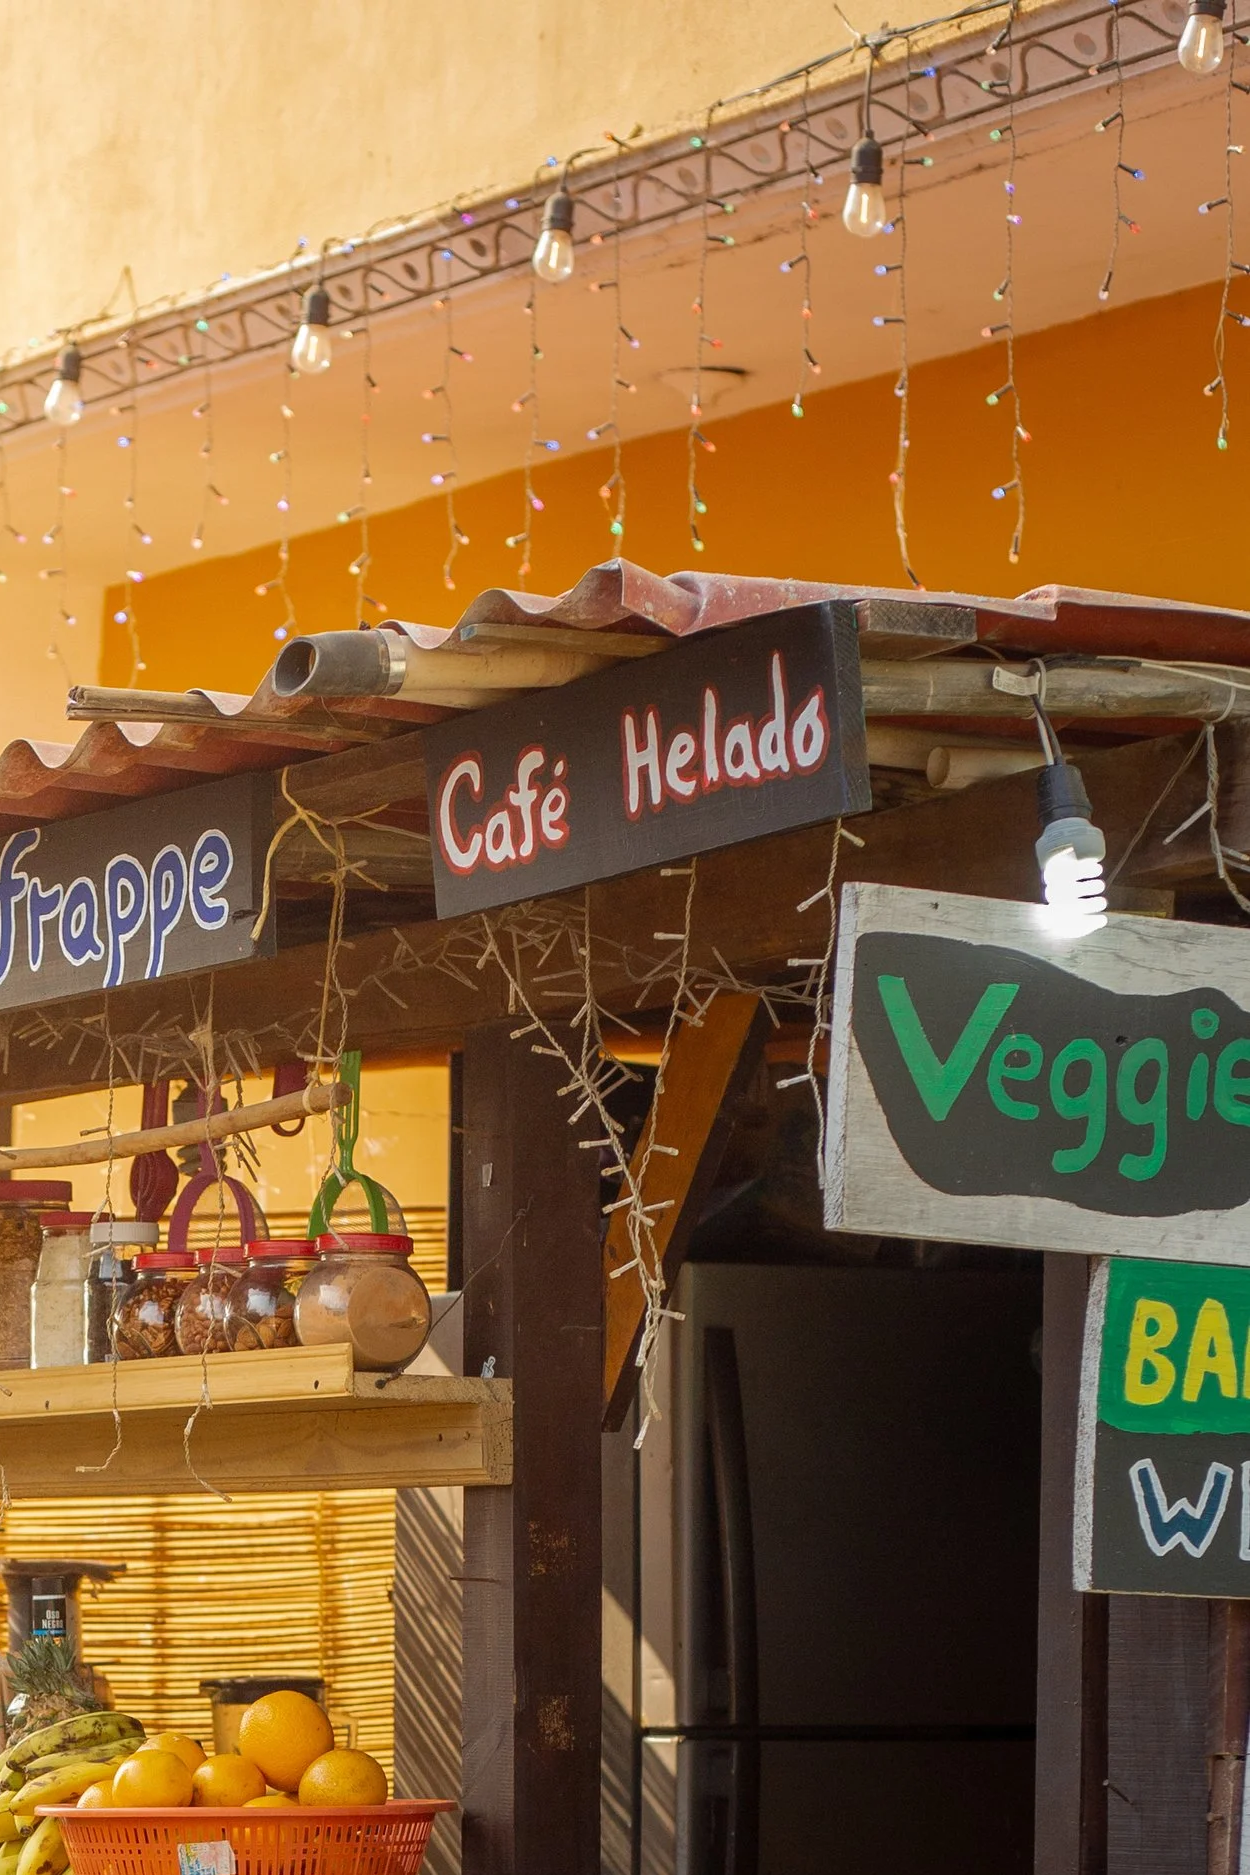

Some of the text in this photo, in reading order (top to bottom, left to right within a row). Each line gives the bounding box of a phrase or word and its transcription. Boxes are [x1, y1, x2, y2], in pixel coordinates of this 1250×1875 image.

[437, 648, 831, 876] Café Helado
[878, 975, 1250, 1181] Veggie
[1123, 1298, 1250, 1406] BA
[1129, 1458, 1250, 1562] W
